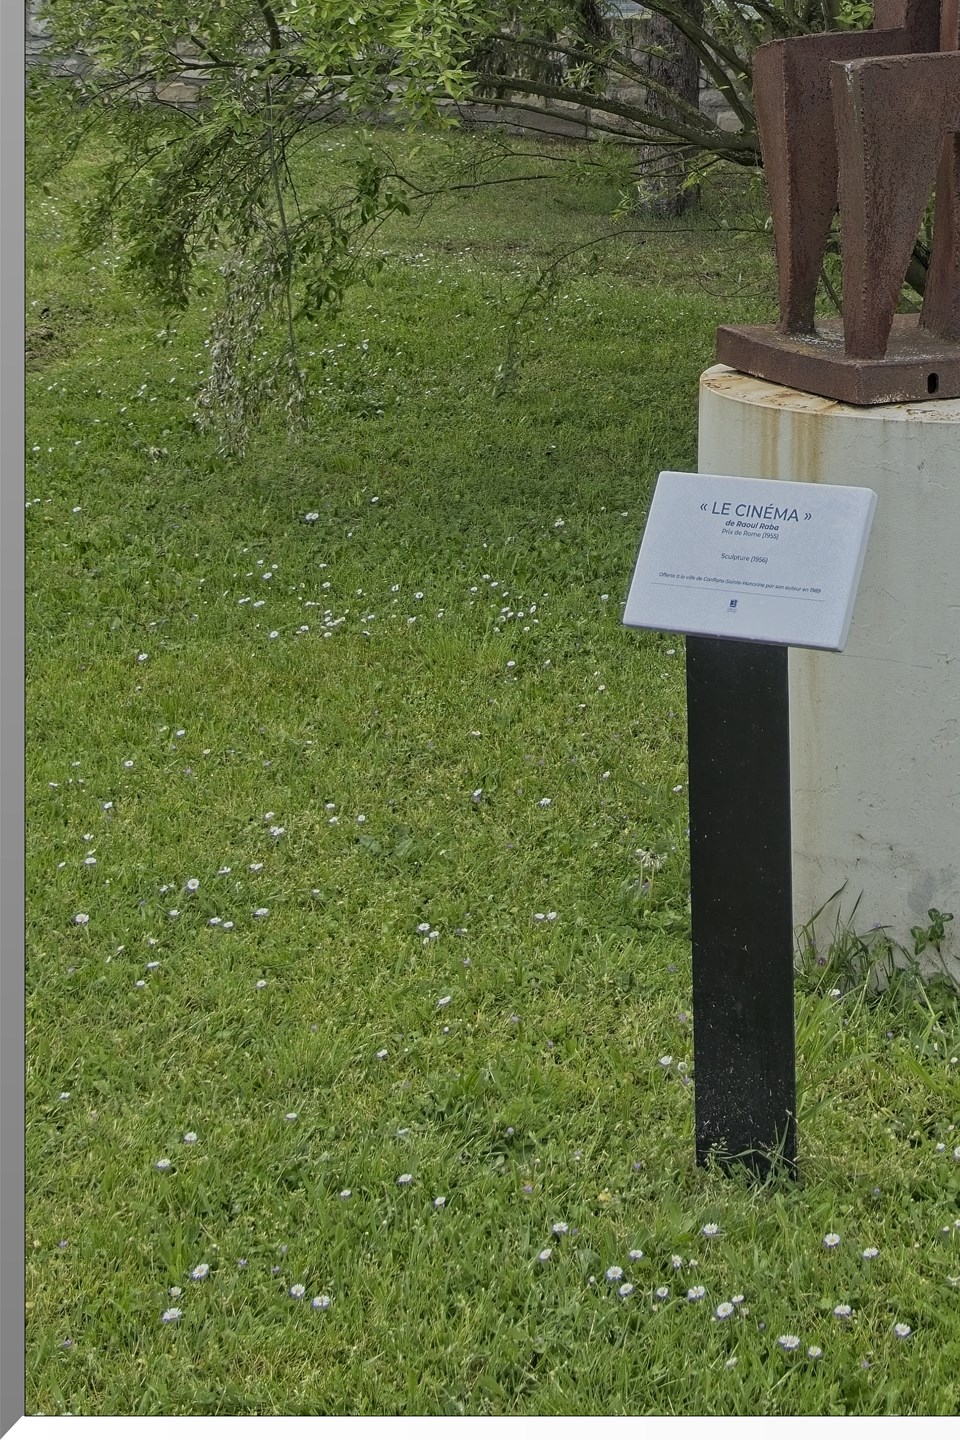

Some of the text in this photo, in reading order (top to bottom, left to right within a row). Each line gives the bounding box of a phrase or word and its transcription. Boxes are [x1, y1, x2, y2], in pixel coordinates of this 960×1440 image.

[711, 501, 732, 516] LE
[735, 503, 799, 522] CINÉMA
[725, 519, 780, 531] de Raoul Raba
[743, 530, 761, 538] Rome
[761, 532, 780, 540] (1955)
[720, 553, 769, 564] Sculpture (1956)
[658, 571, 675, 579] Offerte
